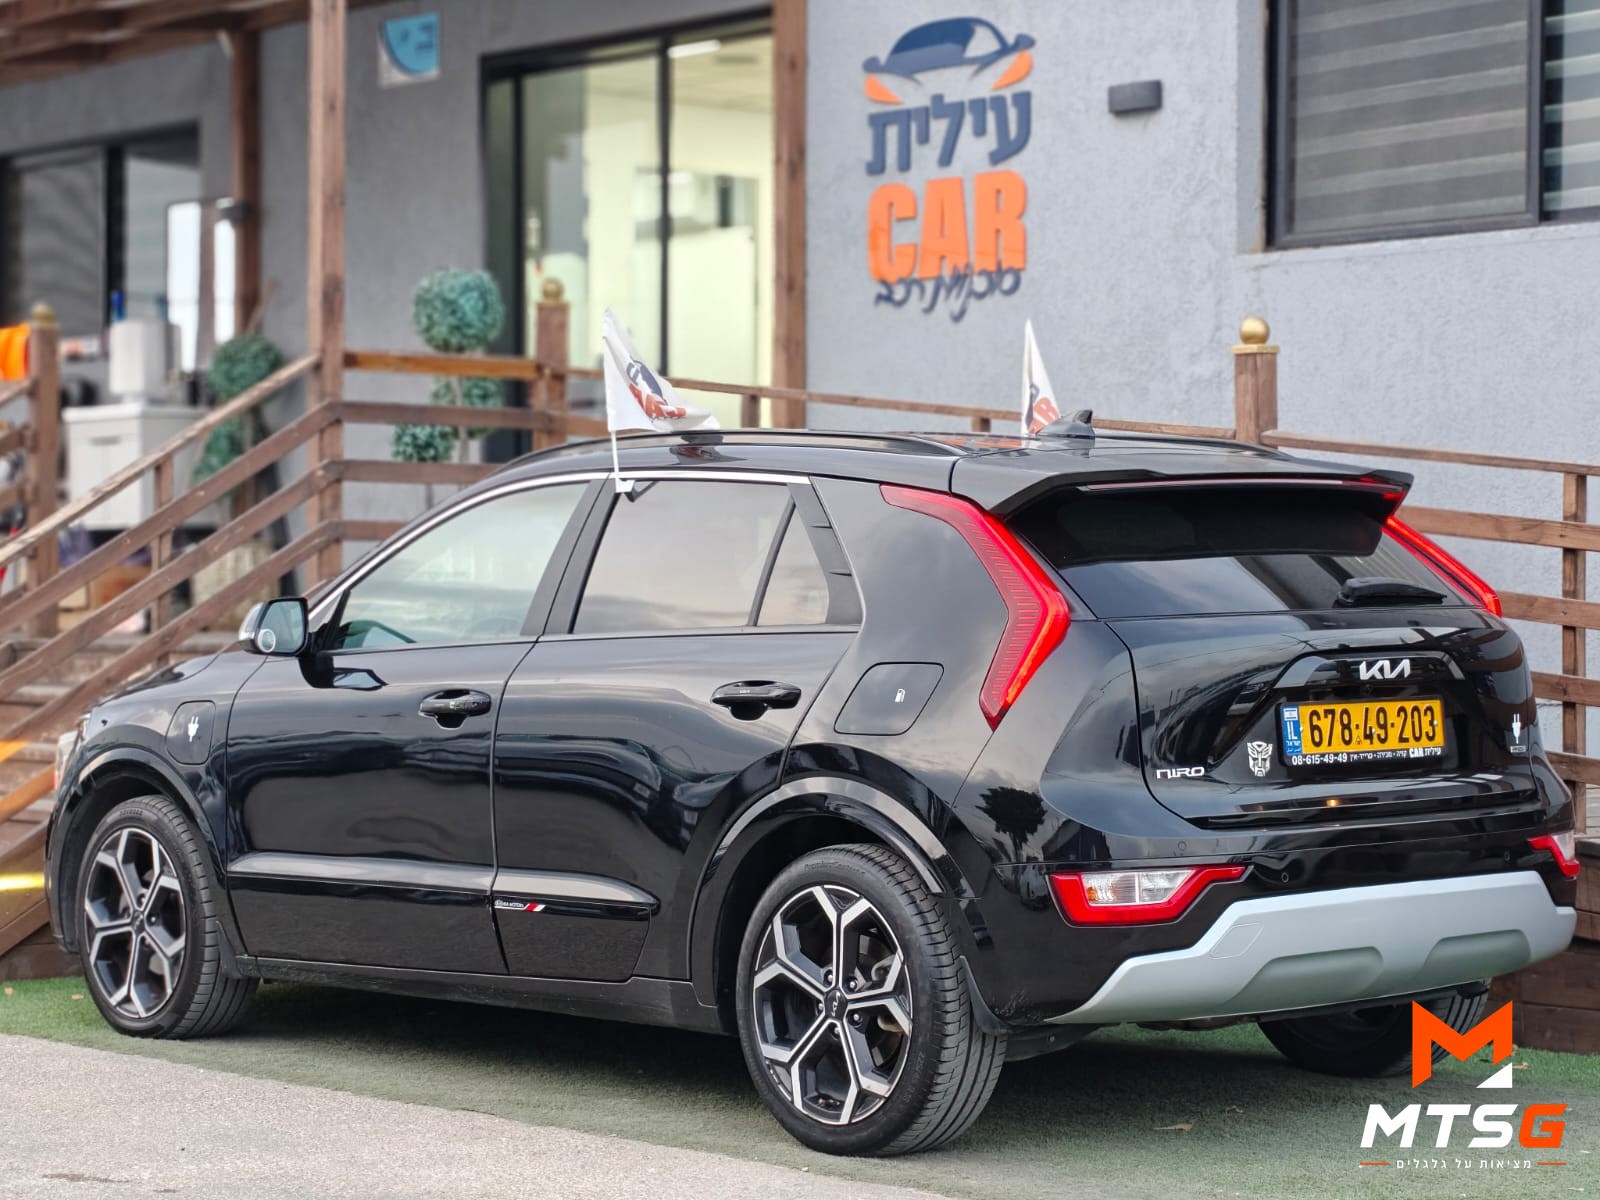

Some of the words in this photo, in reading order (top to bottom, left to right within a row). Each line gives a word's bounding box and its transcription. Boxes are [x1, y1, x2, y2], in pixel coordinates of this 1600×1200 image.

[866, 91, 1032, 176] עילית
[867, 170, 1028, 285] CAR
[1359, 658, 1411, 680] KIA
[1287, 721, 1298, 740] IL
[1291, 753, 1348, 766] 08-615-49-49
